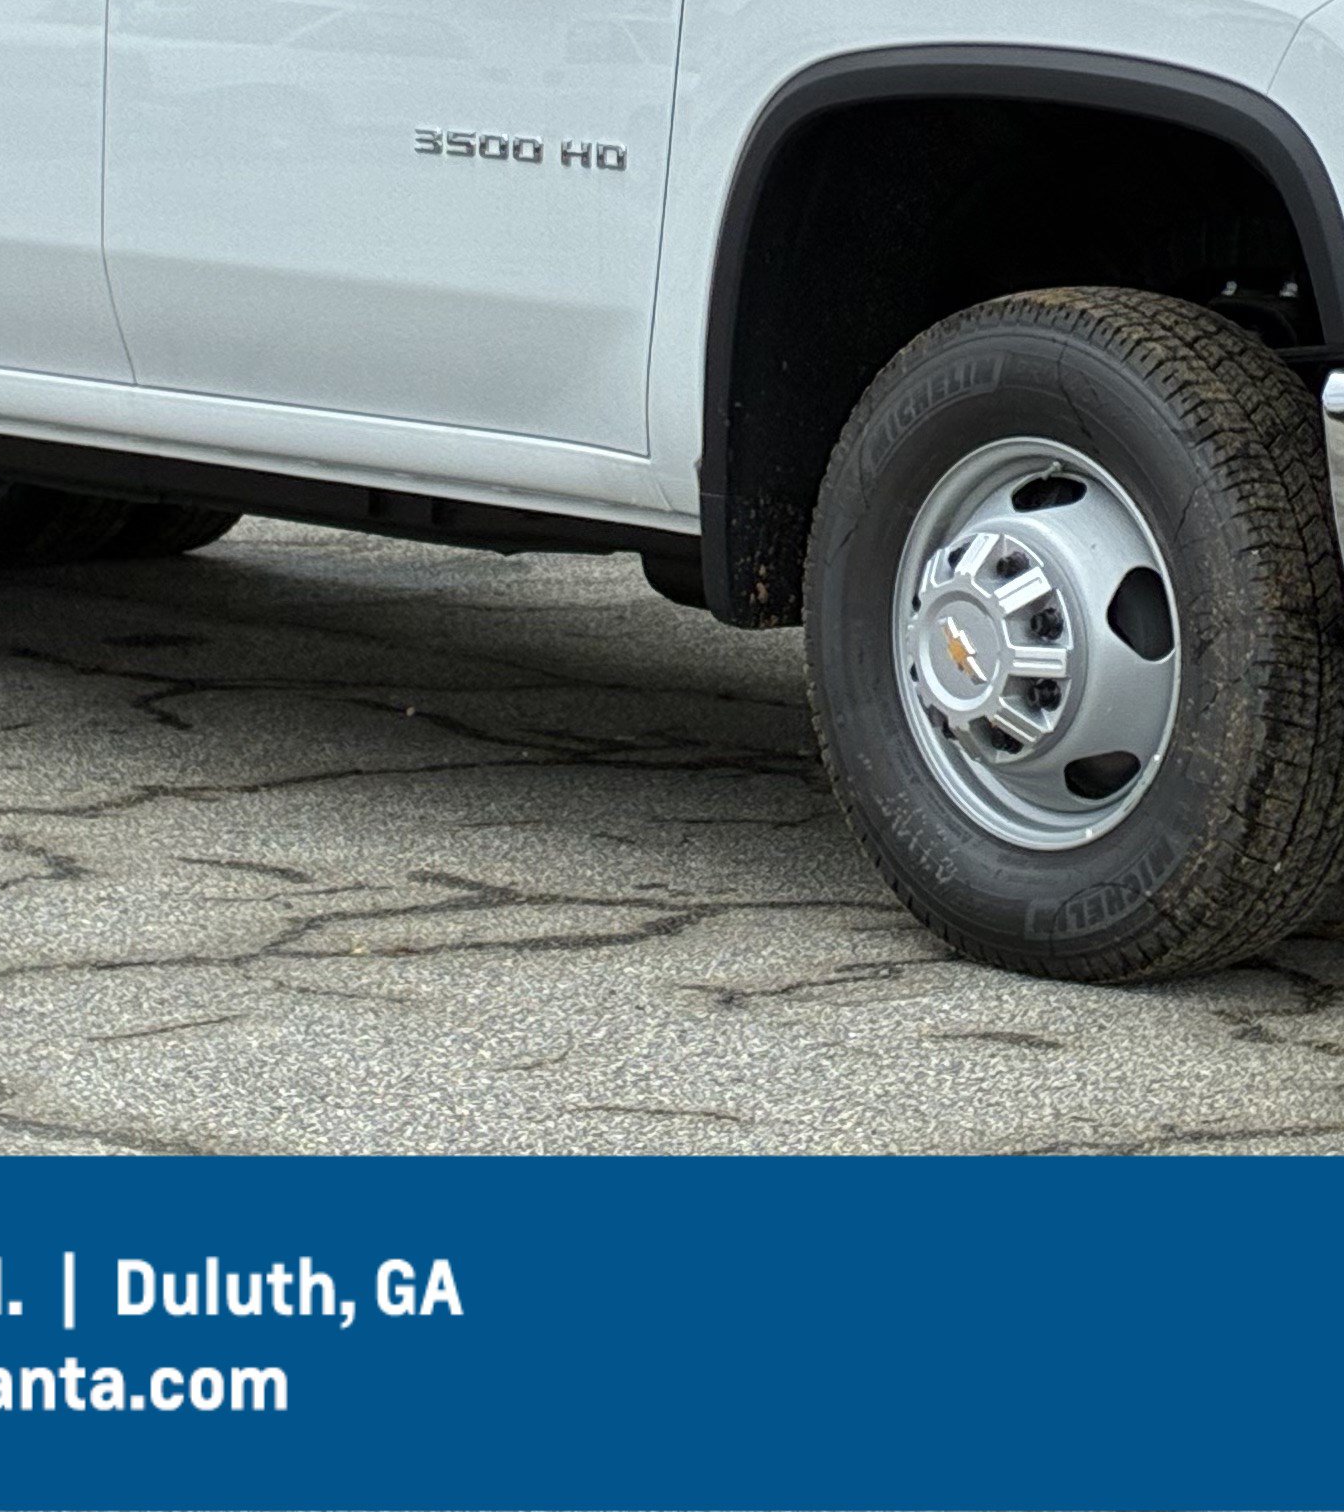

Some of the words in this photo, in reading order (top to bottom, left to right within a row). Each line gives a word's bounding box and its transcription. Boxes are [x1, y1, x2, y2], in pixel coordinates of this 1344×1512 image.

[414, 126, 544, 164] 3500
[560, 139, 628, 171] HD
[867, 354, 1002, 470] MICHELIN
[1033, 833, 1178, 934] MICHELIN
